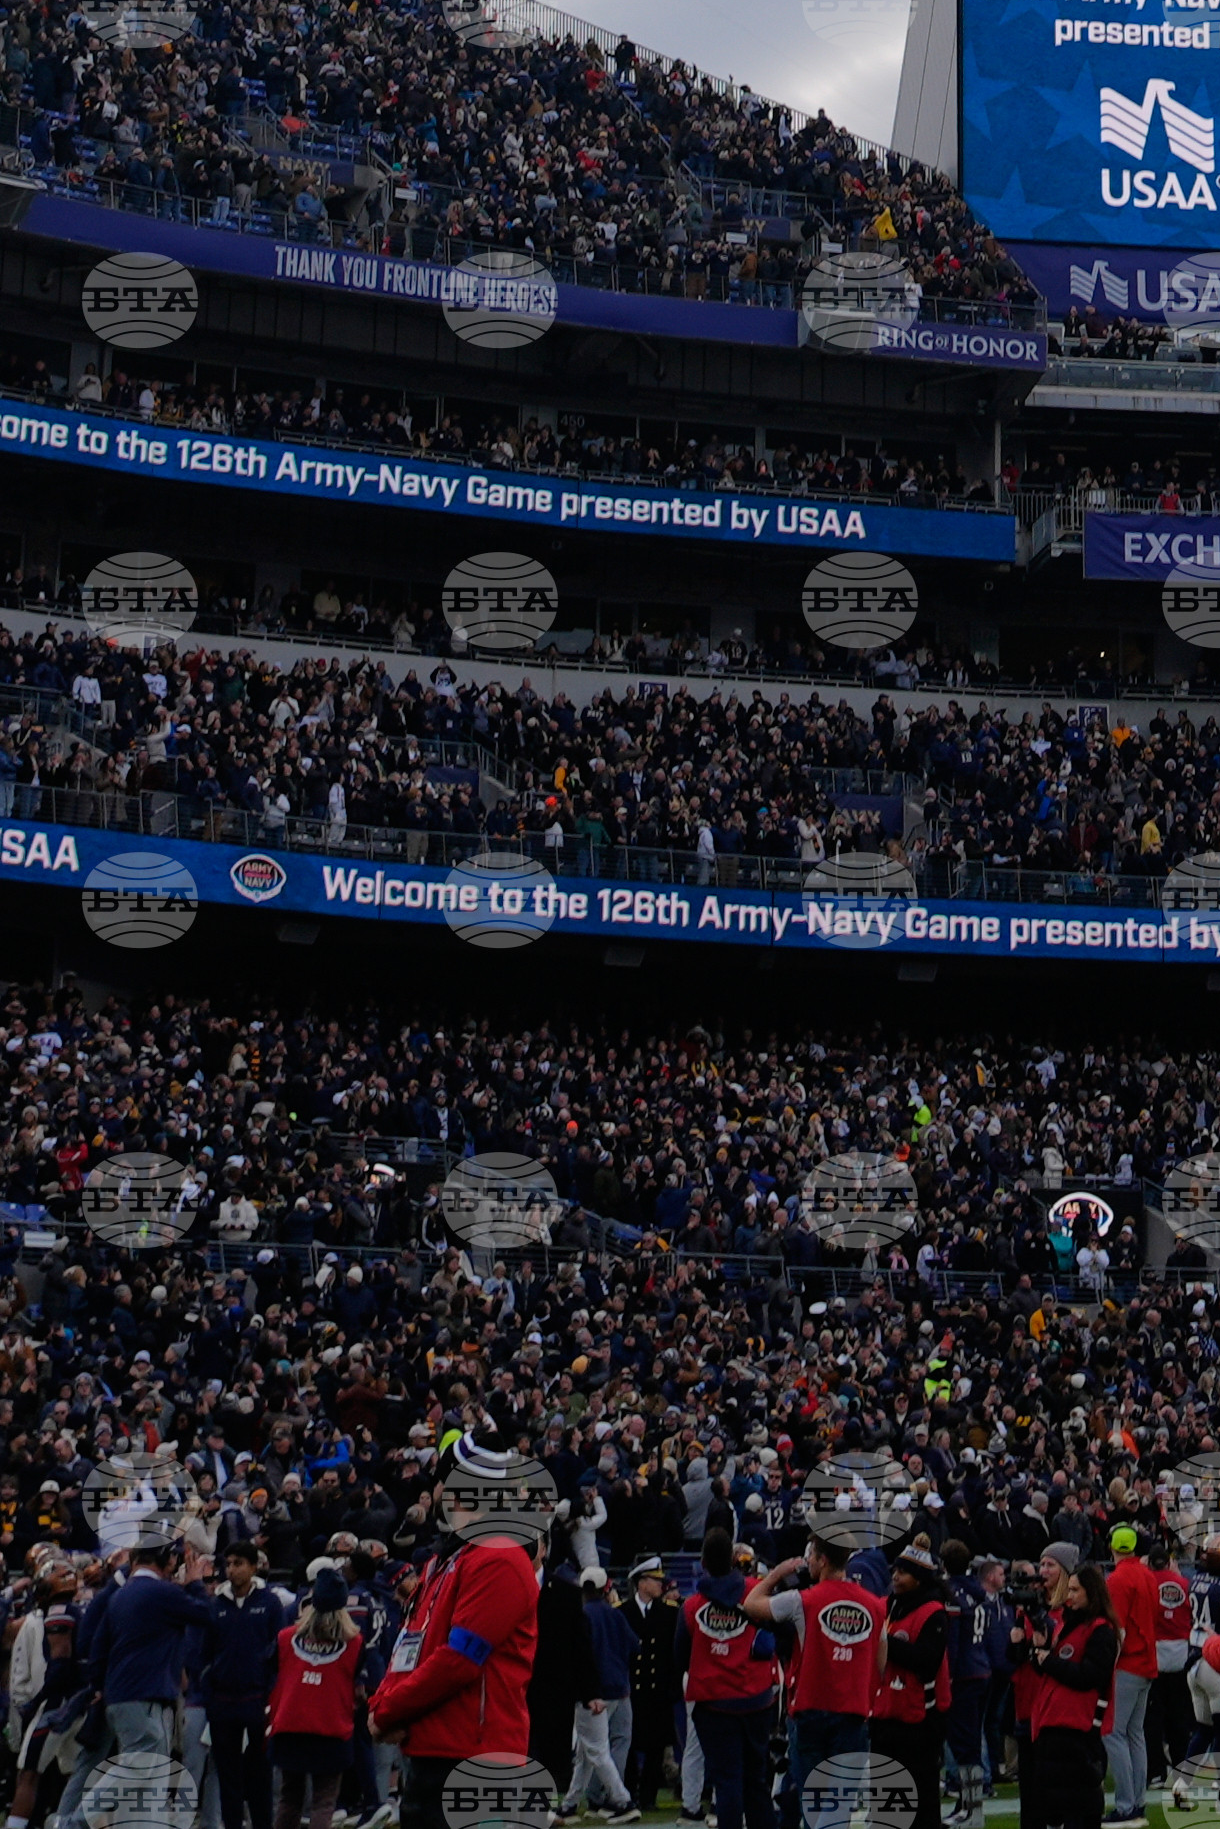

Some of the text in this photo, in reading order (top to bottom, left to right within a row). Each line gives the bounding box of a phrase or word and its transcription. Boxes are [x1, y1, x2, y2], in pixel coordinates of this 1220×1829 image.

[1054, 19, 1210, 51] presented
[275, 245, 556, 316] THANK YOU FRONTLINE HEROES!
[877, 326, 1039, 362] RING OF HONOR
[0, 414, 866, 539] ome to the 126th Army-Navy Game presented by USAA
[0, 828, 79, 872] SAA
[244, 862, 274, 874] ARMY
[244, 876, 273, 889] NAVY
[322, 865, 479, 911] Welcome
[488, 881, 523, 915] to
[533, 883, 588, 920] the
[598, 888, 690, 927] 126th
[698, 895, 897, 946] Army-Navy
[905, 906, 1001, 942] Game
[1010, 917, 1179, 951] presented
[1064, 1202, 1099, 1214] ARY
[765, 1506, 784, 1530] 12
[833, 1607, 863, 1619] ARMY
[709, 1619, 735, 1630] NAVY
[831, 1621, 861, 1634] NAVY
[304, 1641, 332, 1654] NAVY
